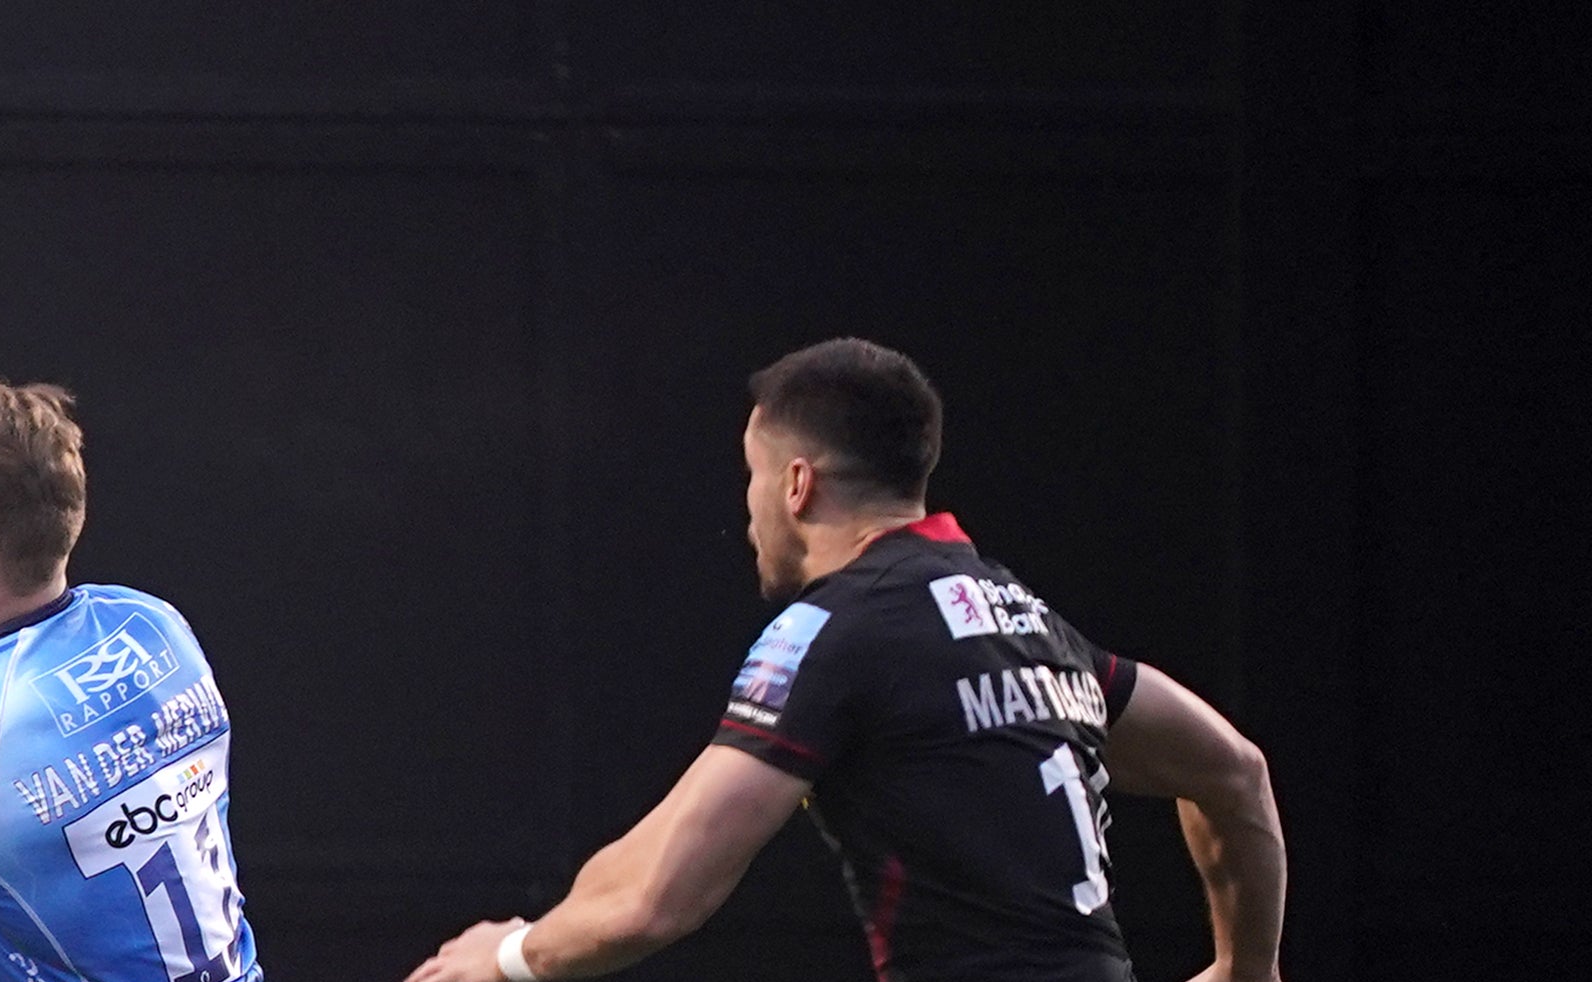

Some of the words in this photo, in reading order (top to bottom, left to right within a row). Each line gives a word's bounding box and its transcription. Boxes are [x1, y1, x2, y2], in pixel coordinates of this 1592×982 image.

[59, 650, 174, 732] RAPPORT
[13, 753, 102, 826] VAN
[93, 724, 156, 788] DER
[104, 794, 179, 849] ebc
[176, 769, 214, 813] group
